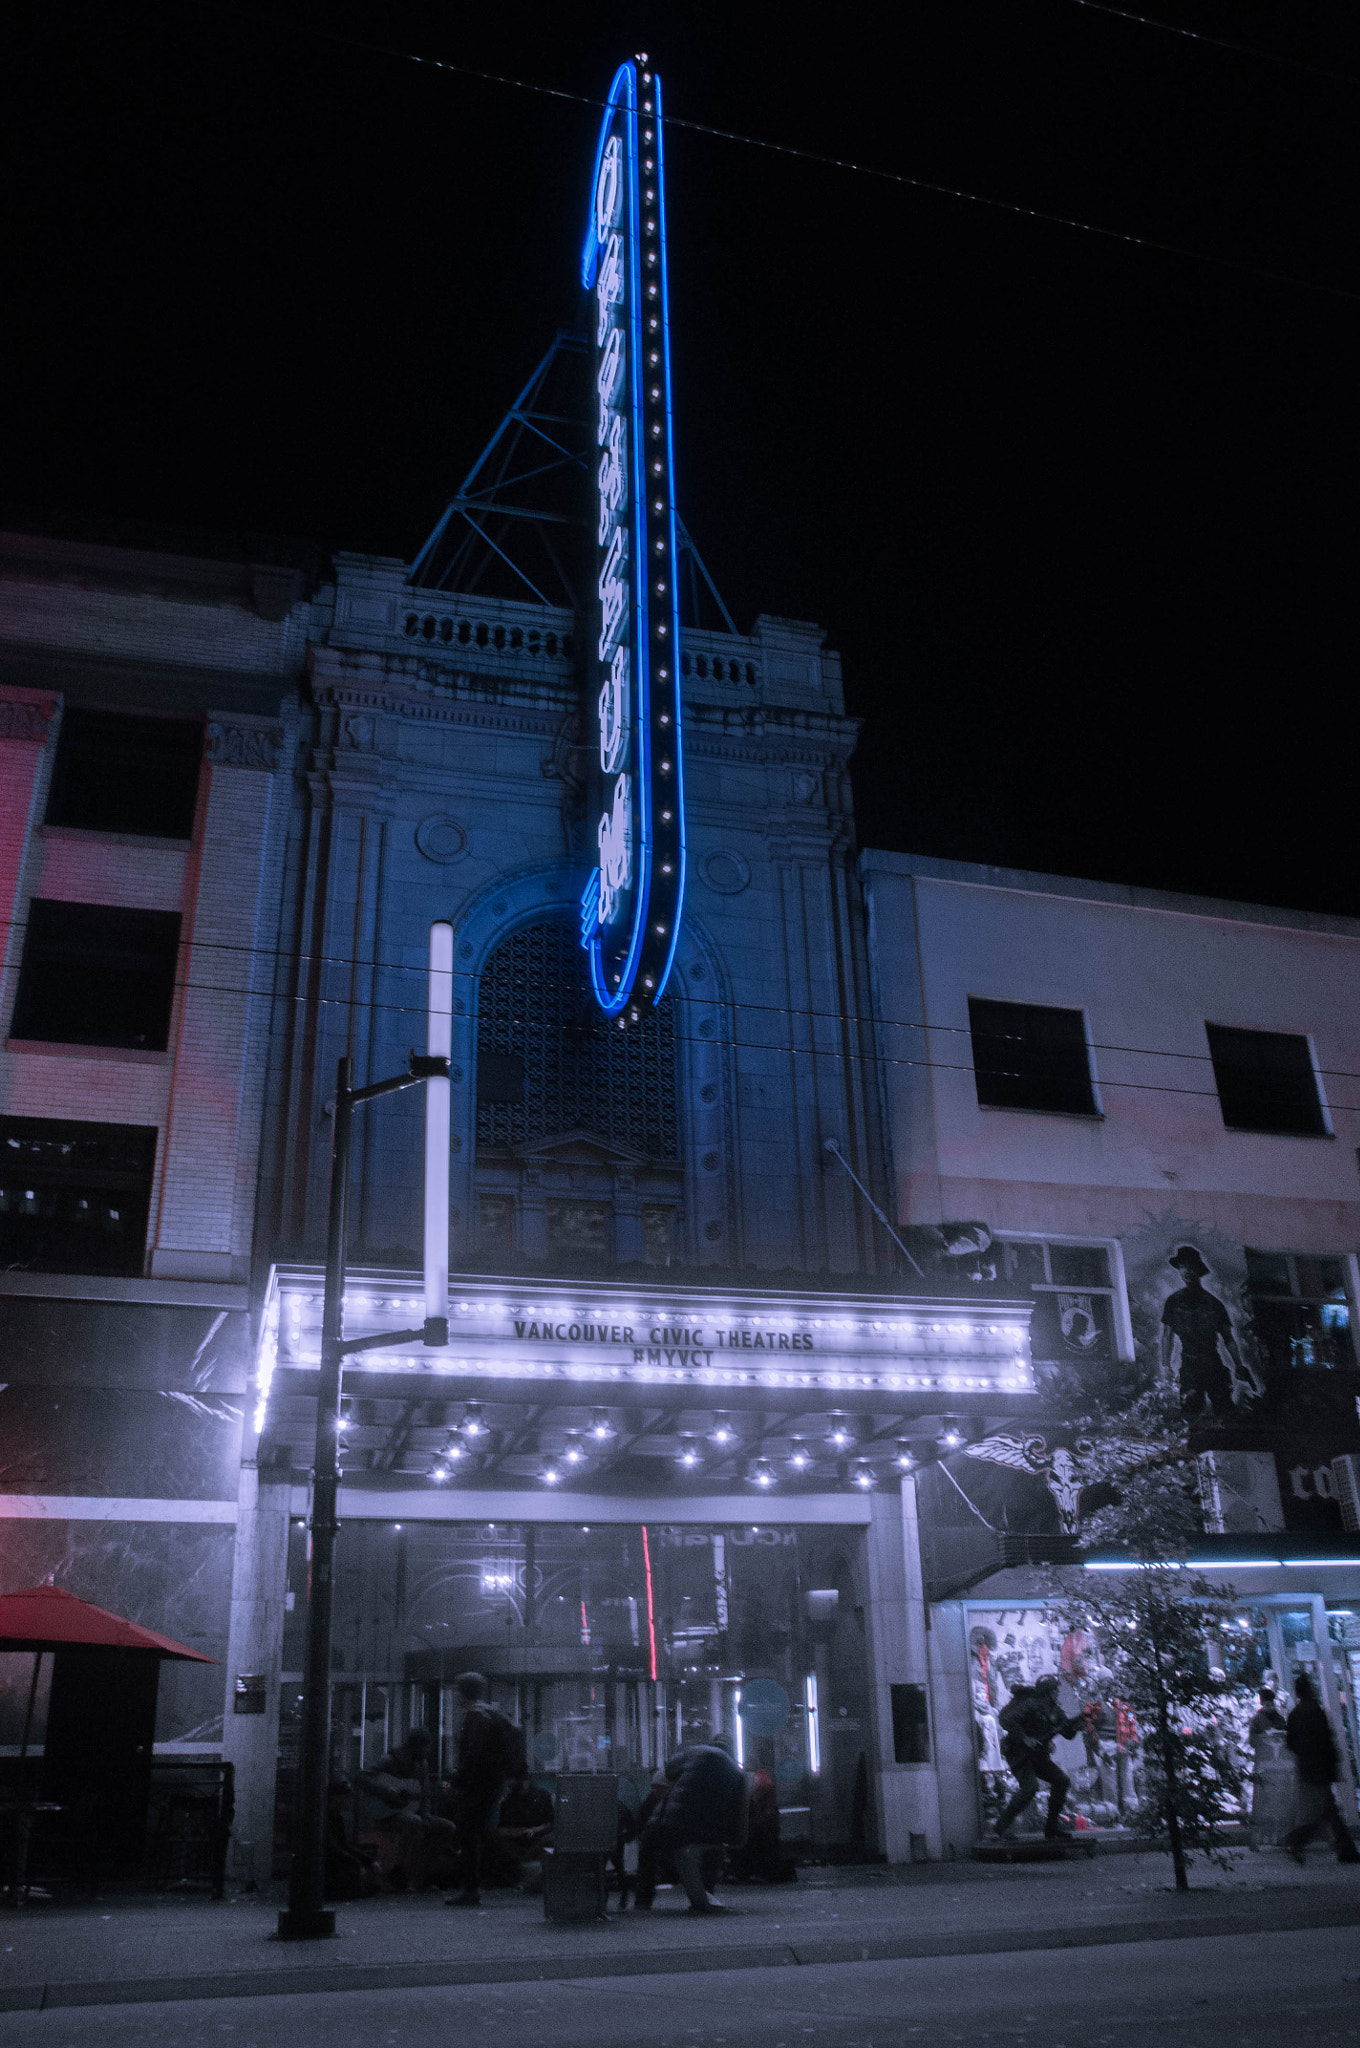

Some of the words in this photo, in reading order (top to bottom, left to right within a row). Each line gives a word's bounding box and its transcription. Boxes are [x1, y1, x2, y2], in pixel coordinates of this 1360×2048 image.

[514, 1321, 634, 1344] VANCOUVER
[650, 1328, 704, 1347] CIVIC
[716, 1330, 814, 1351] THEATRES
[633, 1348, 714, 1367] #MYVCT
